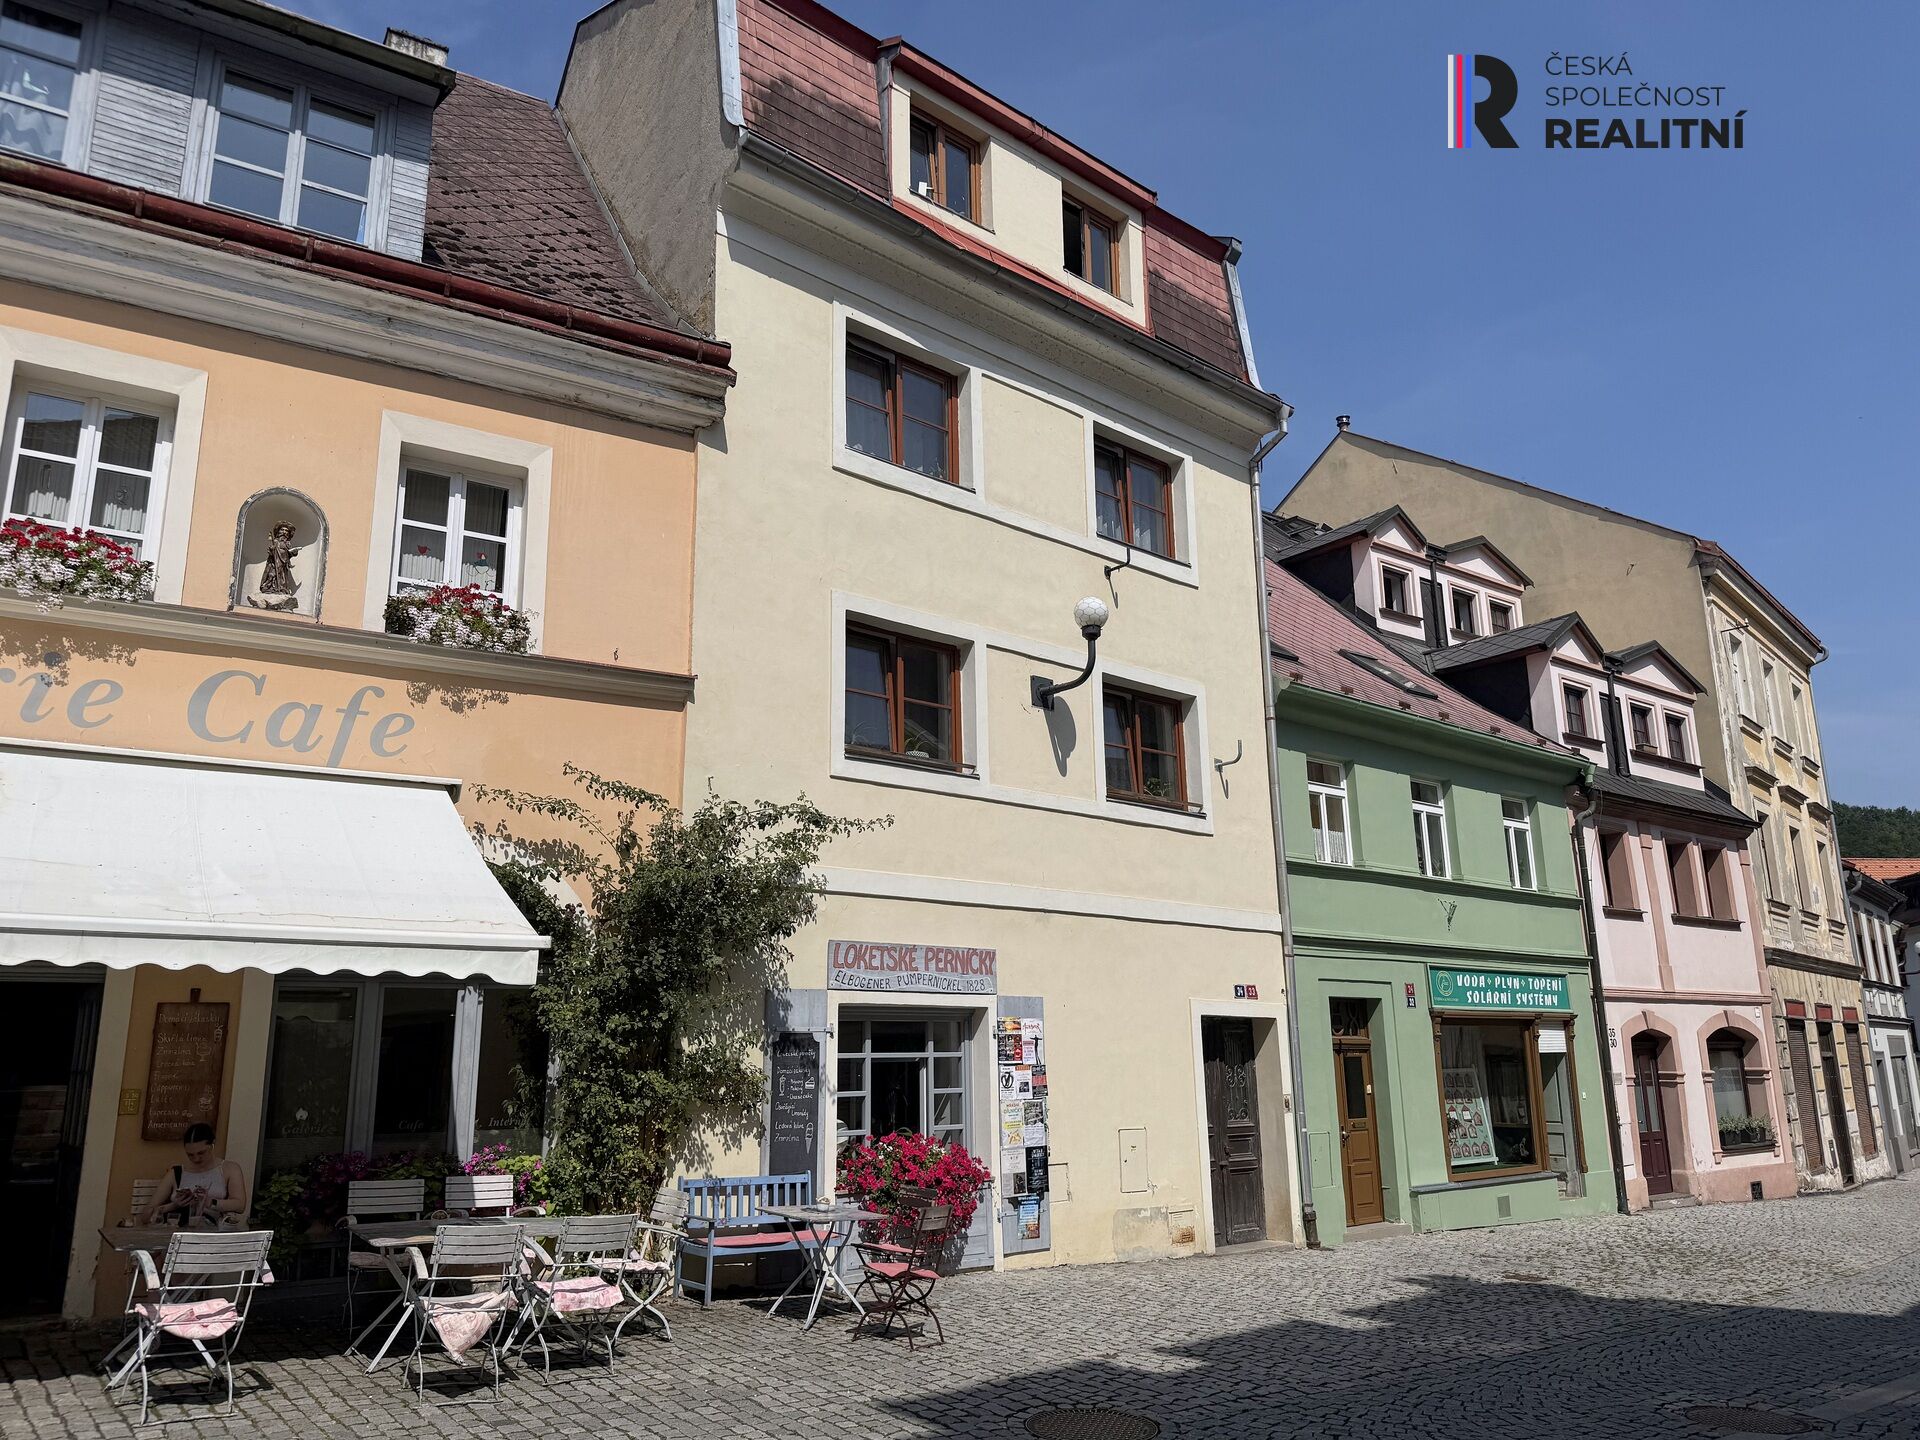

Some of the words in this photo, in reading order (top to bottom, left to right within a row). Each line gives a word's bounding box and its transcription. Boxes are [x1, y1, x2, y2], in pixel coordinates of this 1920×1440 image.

[187, 669, 416, 767] Cafe
[832, 943, 919, 972] LOKETSKÉ
[924, 947, 997, 976] PERNÍČKY
[834, 970, 891, 990] ELBOGENER
[896, 973, 962, 992] PUMPERNICKEL
[966, 978, 986, 992] 1828
[1456, 974, 1486, 988] VODA
[1494, 976, 1520, 990] PLYN
[1527, 977, 1563, 992] TOPENÍ
[1466, 988, 1512, 1005] SOLÁRNÍ
[1516, 991, 1559, 1006] SYSTÉMY
